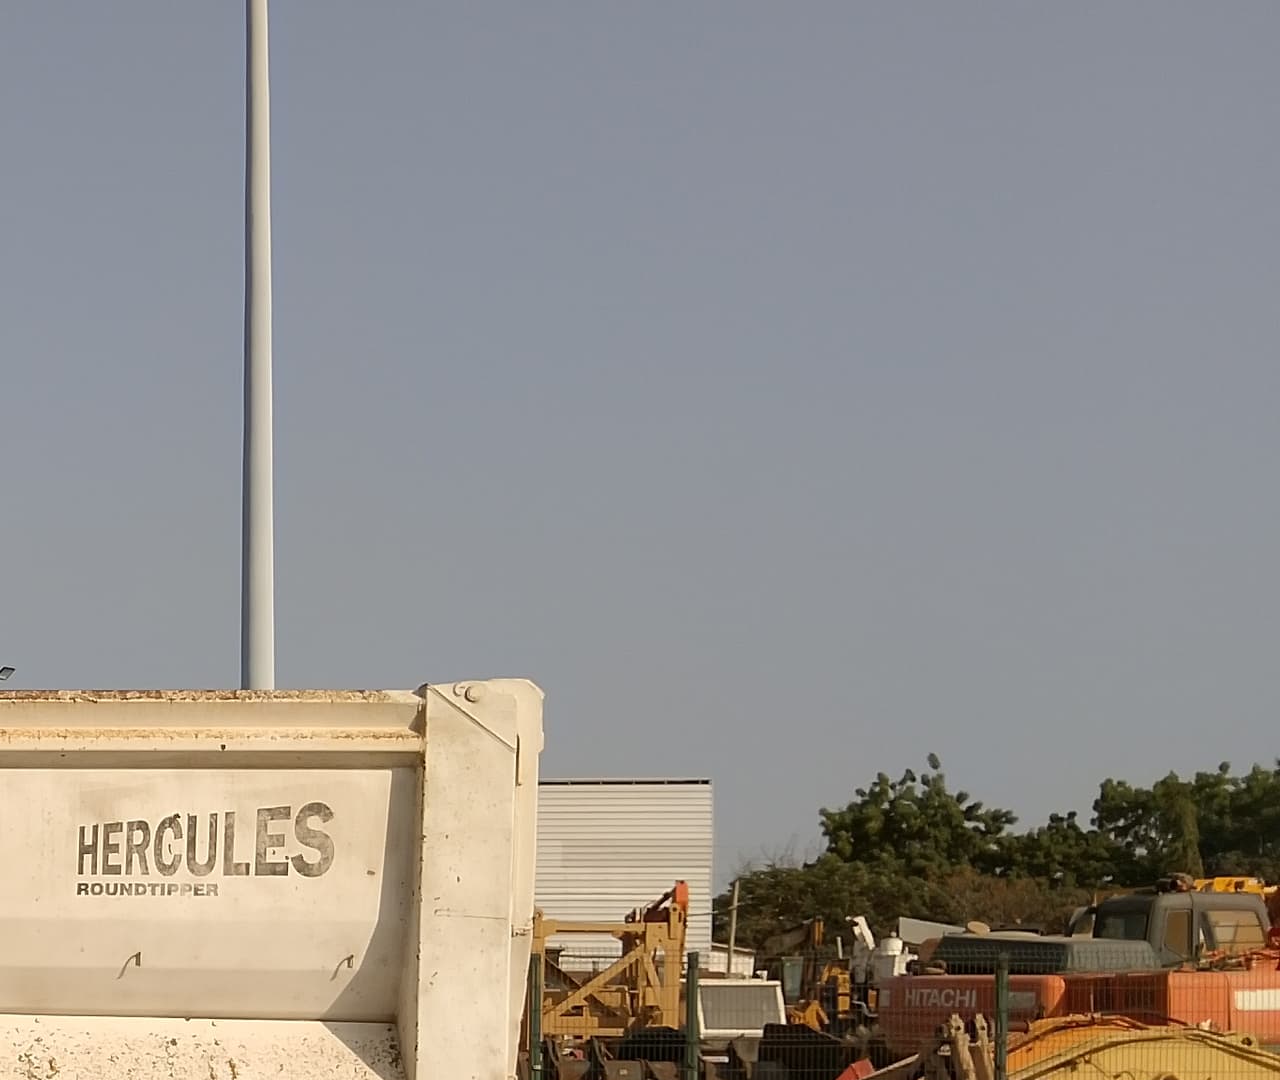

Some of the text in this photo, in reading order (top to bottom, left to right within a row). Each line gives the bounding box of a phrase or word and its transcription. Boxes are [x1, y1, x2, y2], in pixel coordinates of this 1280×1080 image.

[77, 802, 335, 878] HERCULES
[76, 882, 219, 897] ROUNDTIPPER
[904, 988, 977, 1008] HITACHI
